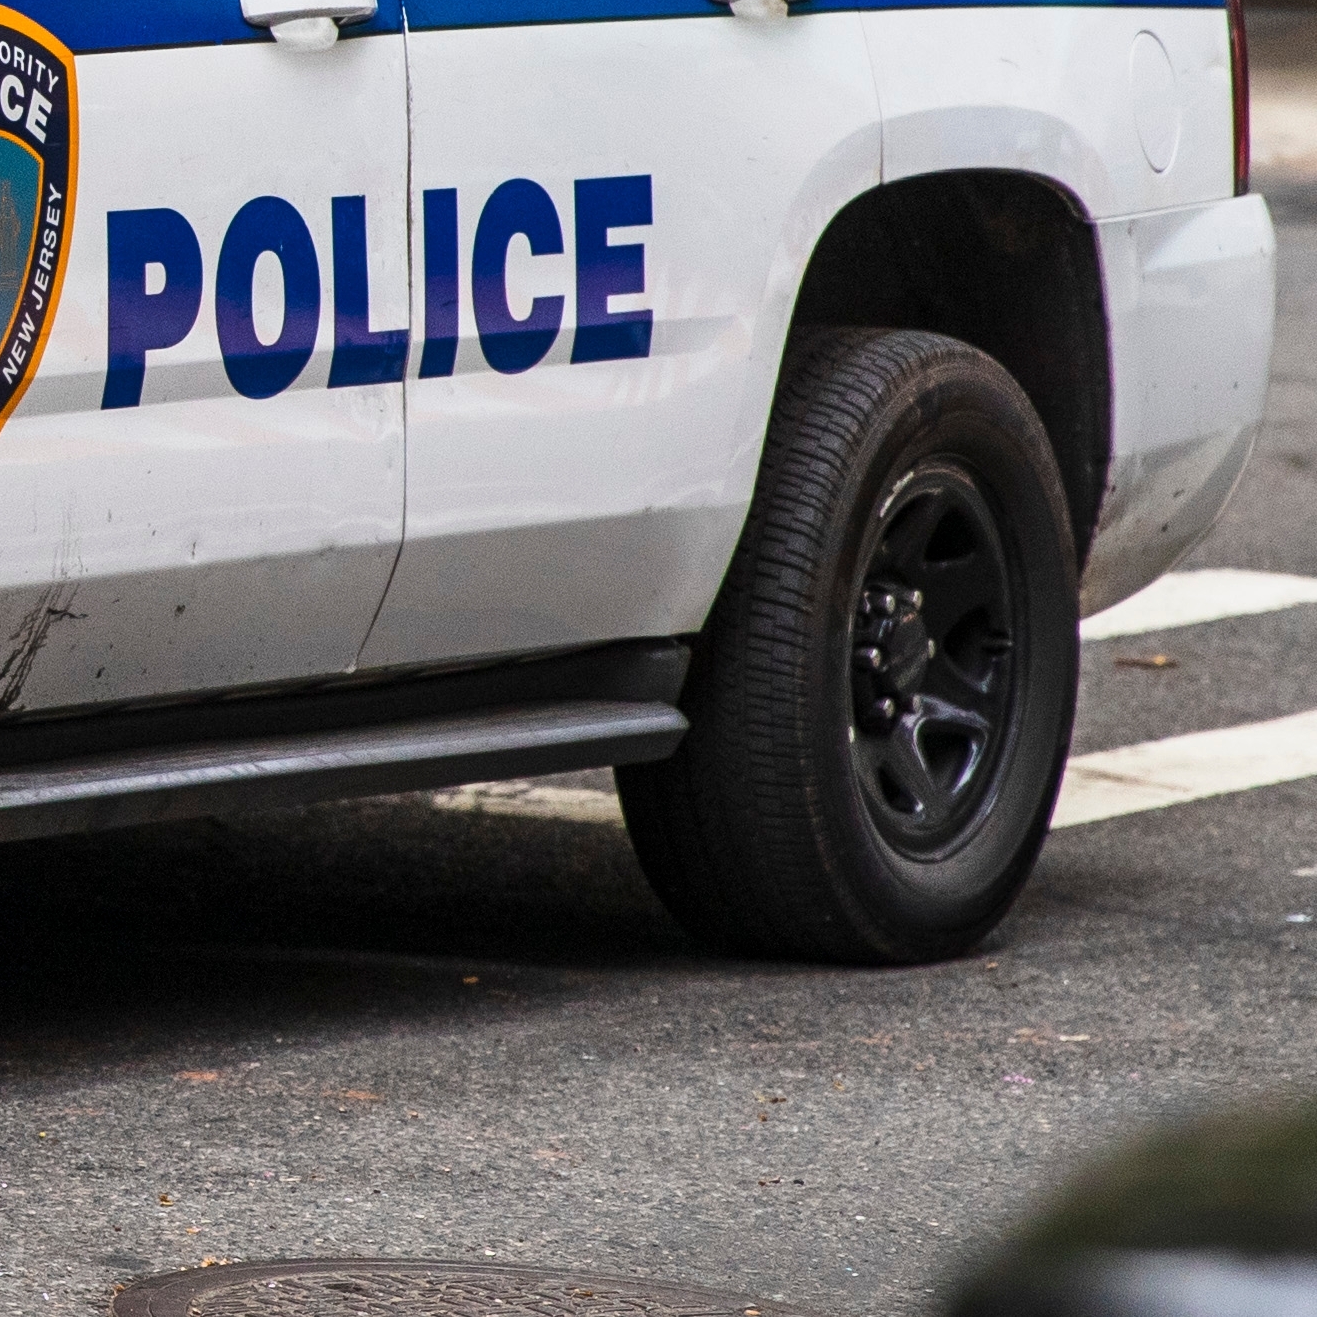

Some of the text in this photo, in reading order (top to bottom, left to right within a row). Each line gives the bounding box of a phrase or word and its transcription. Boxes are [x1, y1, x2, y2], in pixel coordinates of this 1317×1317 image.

[1, 182, 63, 385] NEW JERSEY
[100, 174, 654, 411] POLICE
